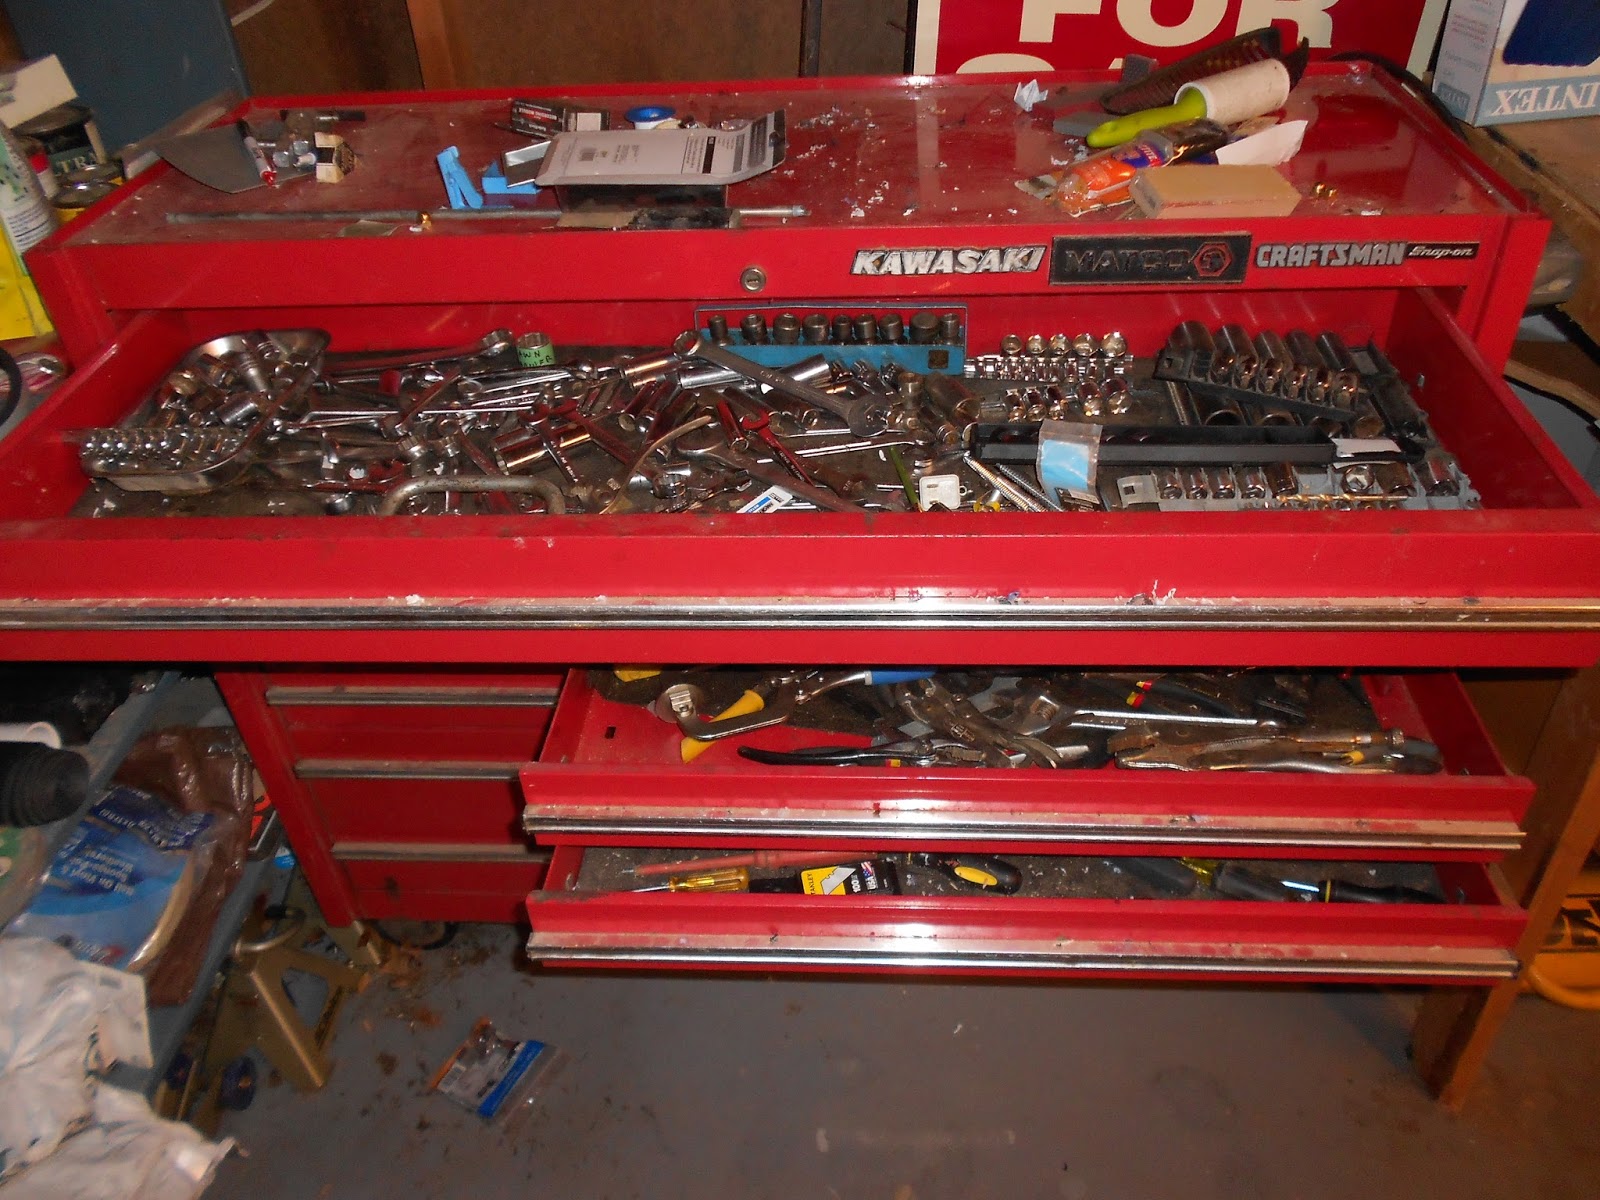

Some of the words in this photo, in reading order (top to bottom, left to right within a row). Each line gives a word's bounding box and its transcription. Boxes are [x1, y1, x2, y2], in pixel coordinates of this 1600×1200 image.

[1491, 82, 1600, 117] INTEX
[852, 245, 1047, 275] KAWASAKI
[1064, 249, 1190, 273] MATCO
[1256, 242, 1408, 268] CRAFTSMAN
[1408, 245, 1474, 260] Snap-on
